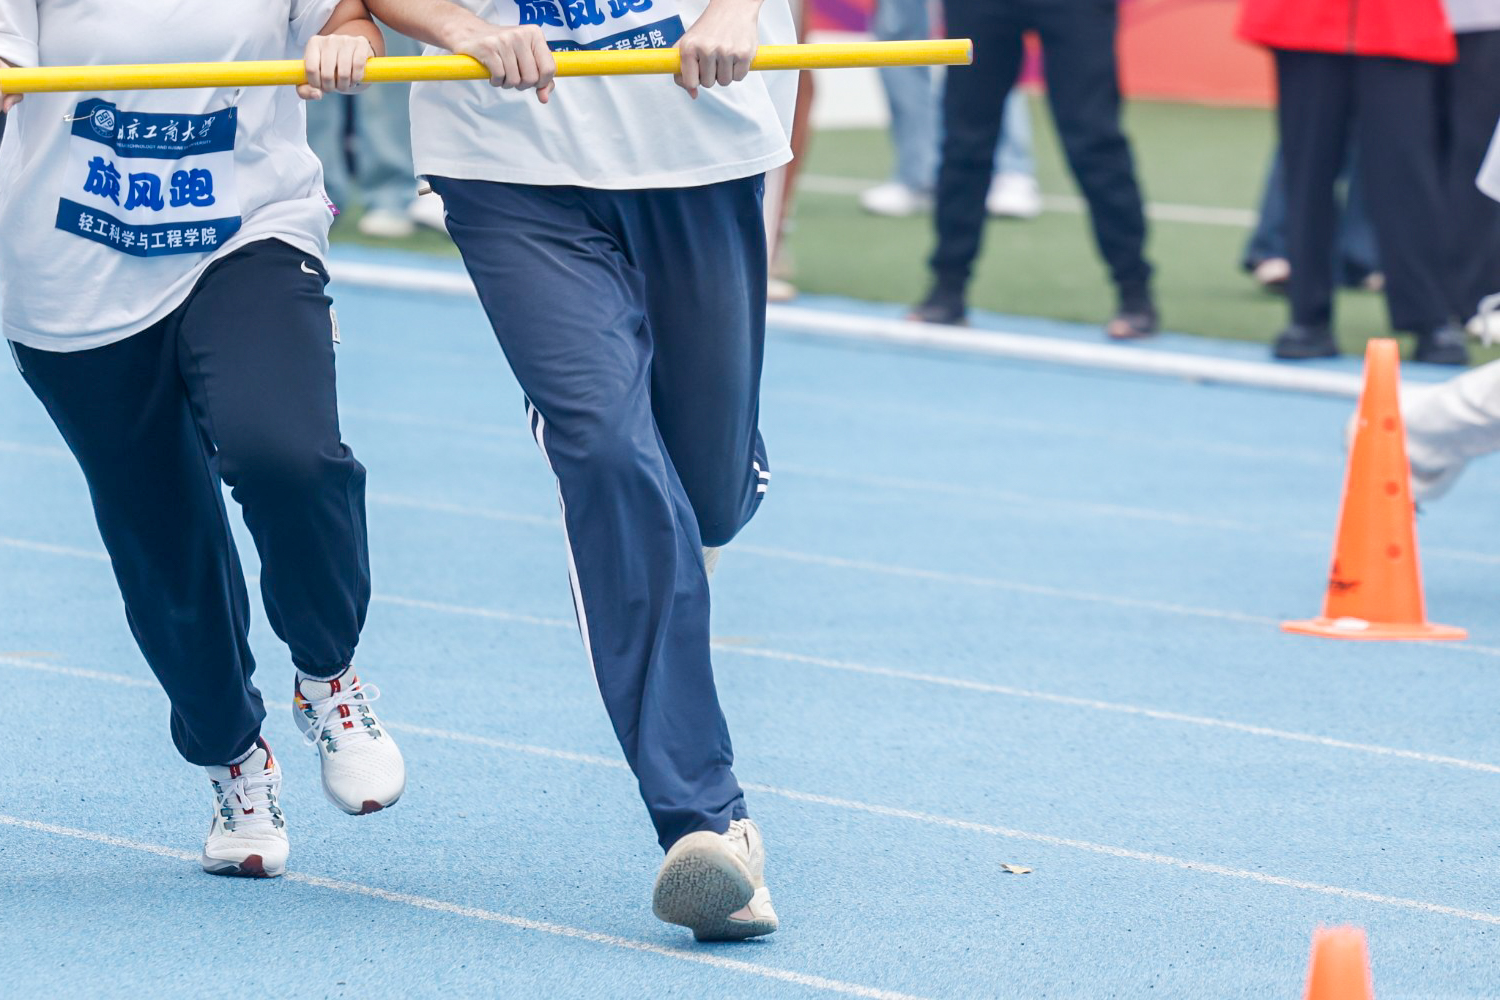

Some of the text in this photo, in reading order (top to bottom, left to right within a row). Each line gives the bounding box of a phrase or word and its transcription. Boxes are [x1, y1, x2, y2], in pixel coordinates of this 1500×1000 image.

[83, 156, 216, 211] 旋风跑
[78, 212, 218, 250] 轻工科学与工程学院
